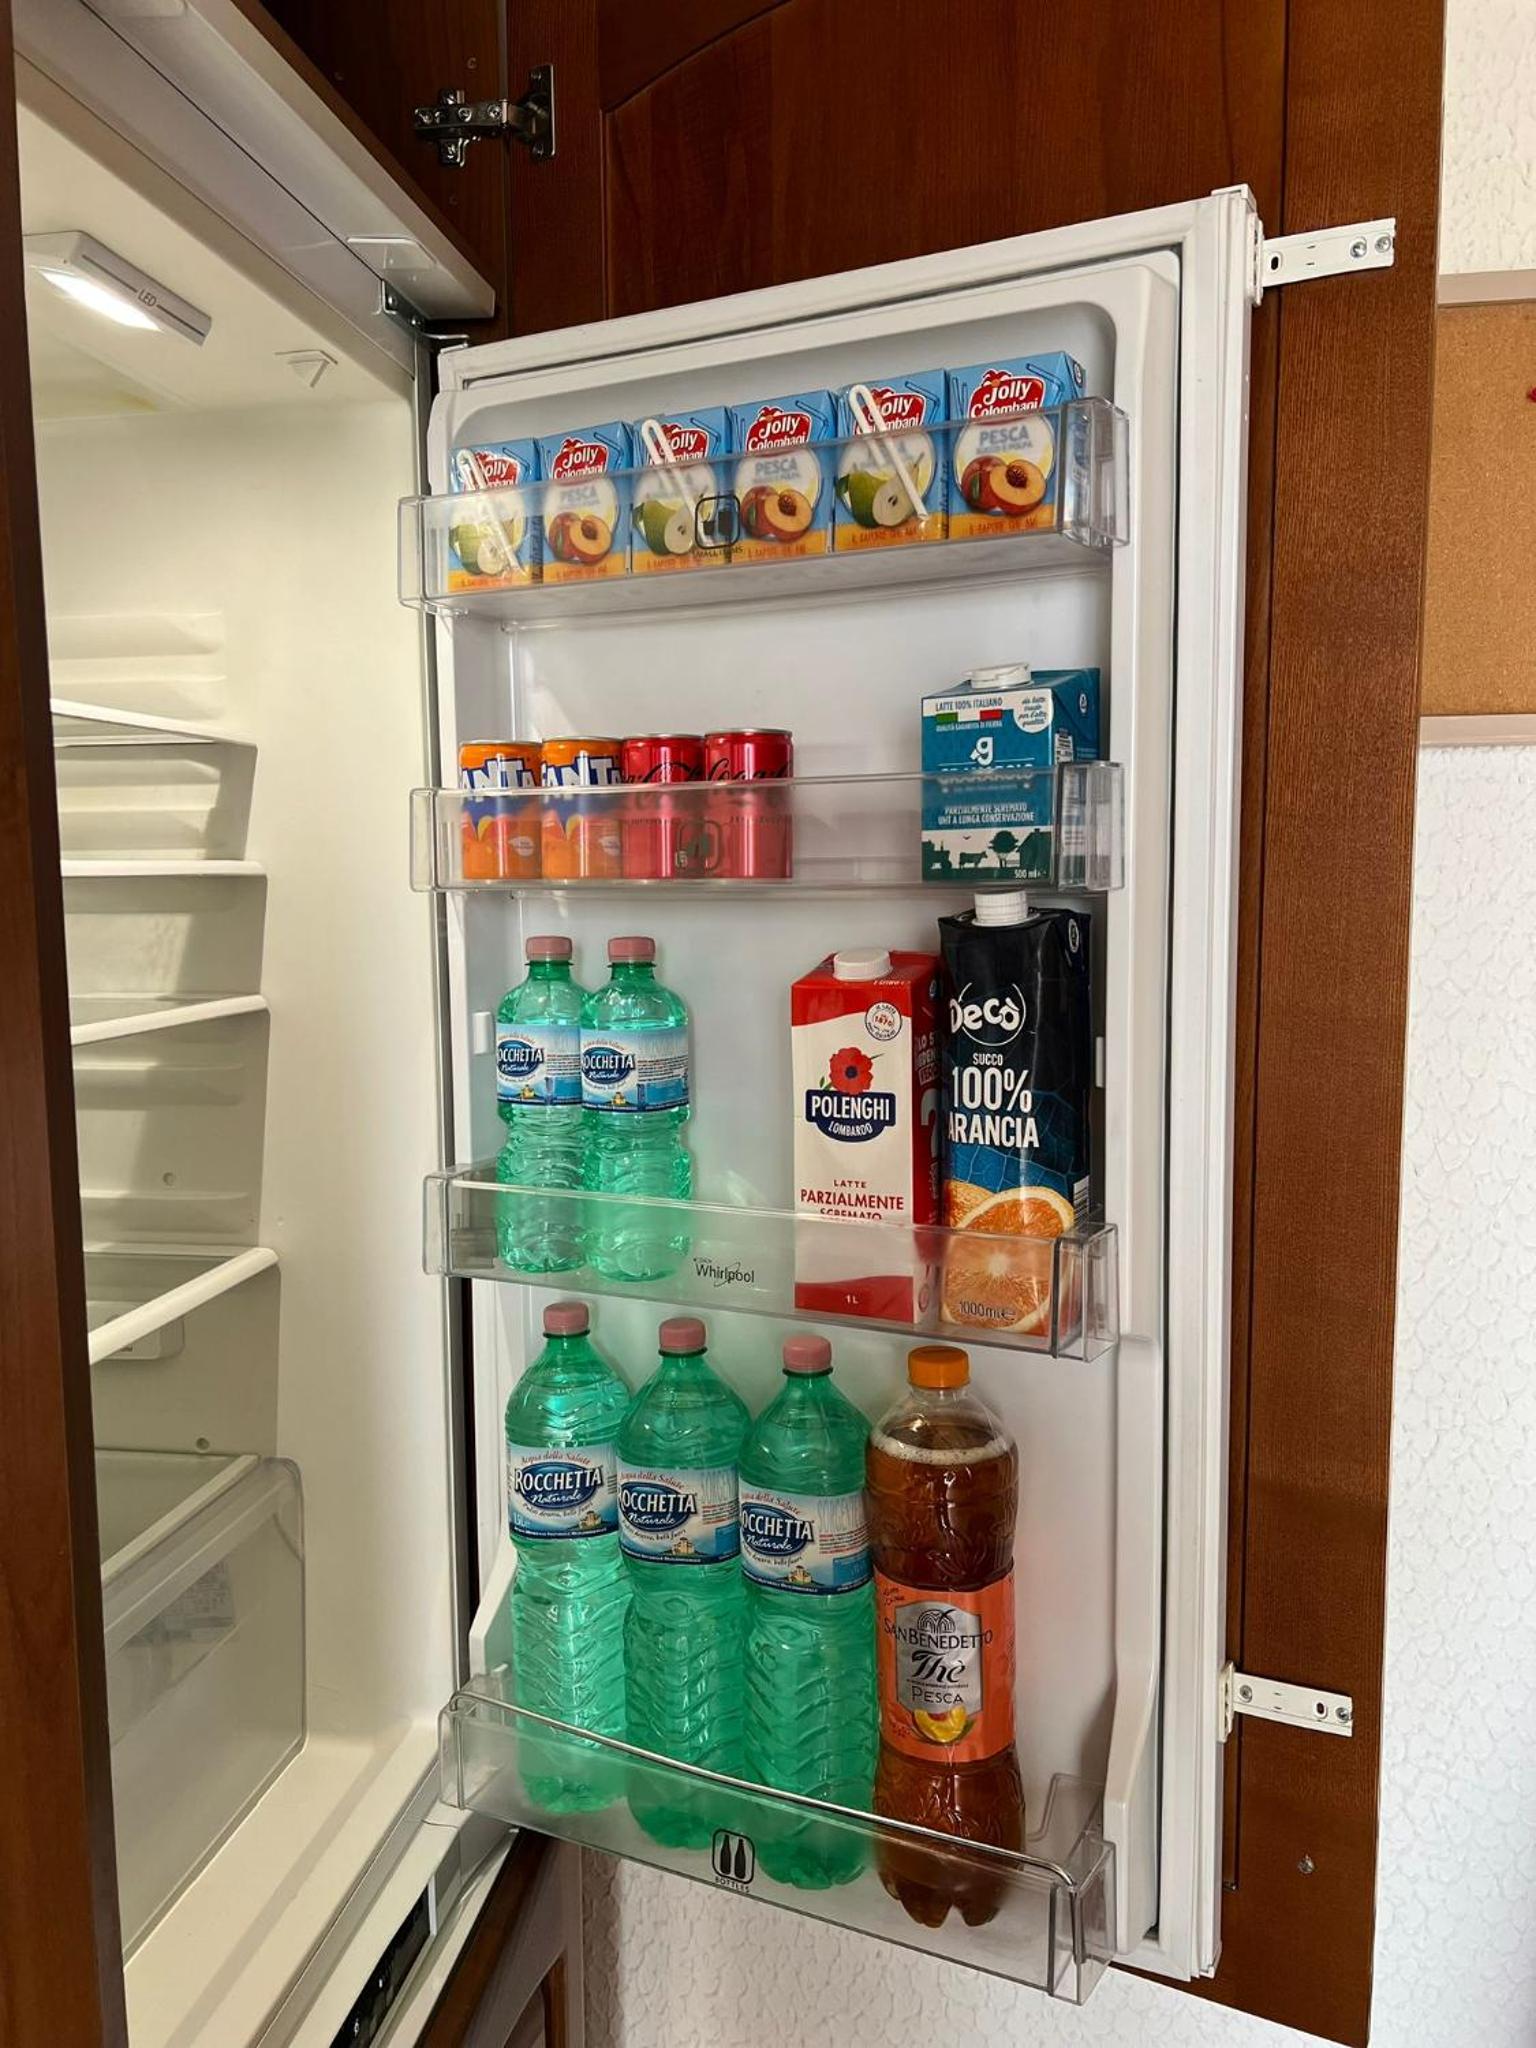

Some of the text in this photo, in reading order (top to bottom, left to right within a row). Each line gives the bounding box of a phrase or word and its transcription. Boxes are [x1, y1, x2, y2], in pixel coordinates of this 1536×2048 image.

[138, 289, 157, 308] LED
[983, 378, 1033, 407] Jolly
[758, 416, 800, 440] Jolly
[979, 425, 1030, 448] PESCA
[562, 445, 599, 469] Jolly
[755, 458, 799, 478] PESCA
[972, 1053, 1004, 1067] SUCCO
[951, 1066, 1033, 1114] 100%
[811, 1095, 890, 1121] POLENGHI
[828, 1120, 874, 1137] LOMBARDO
[833, 1179, 867, 1189] LATTE
[800, 1189, 904, 1211] PARZIALMENTE
[695, 1262, 755, 1286] Whirlpool
[515, 1467, 602, 1495] ROCCHETTA
[531, 1489, 583, 1504] Naturale
[628, 1512, 675, 1525] Naturale
[746, 1535, 793, 1550] Naturale
[911, 1686, 965, 1705] PESCA
